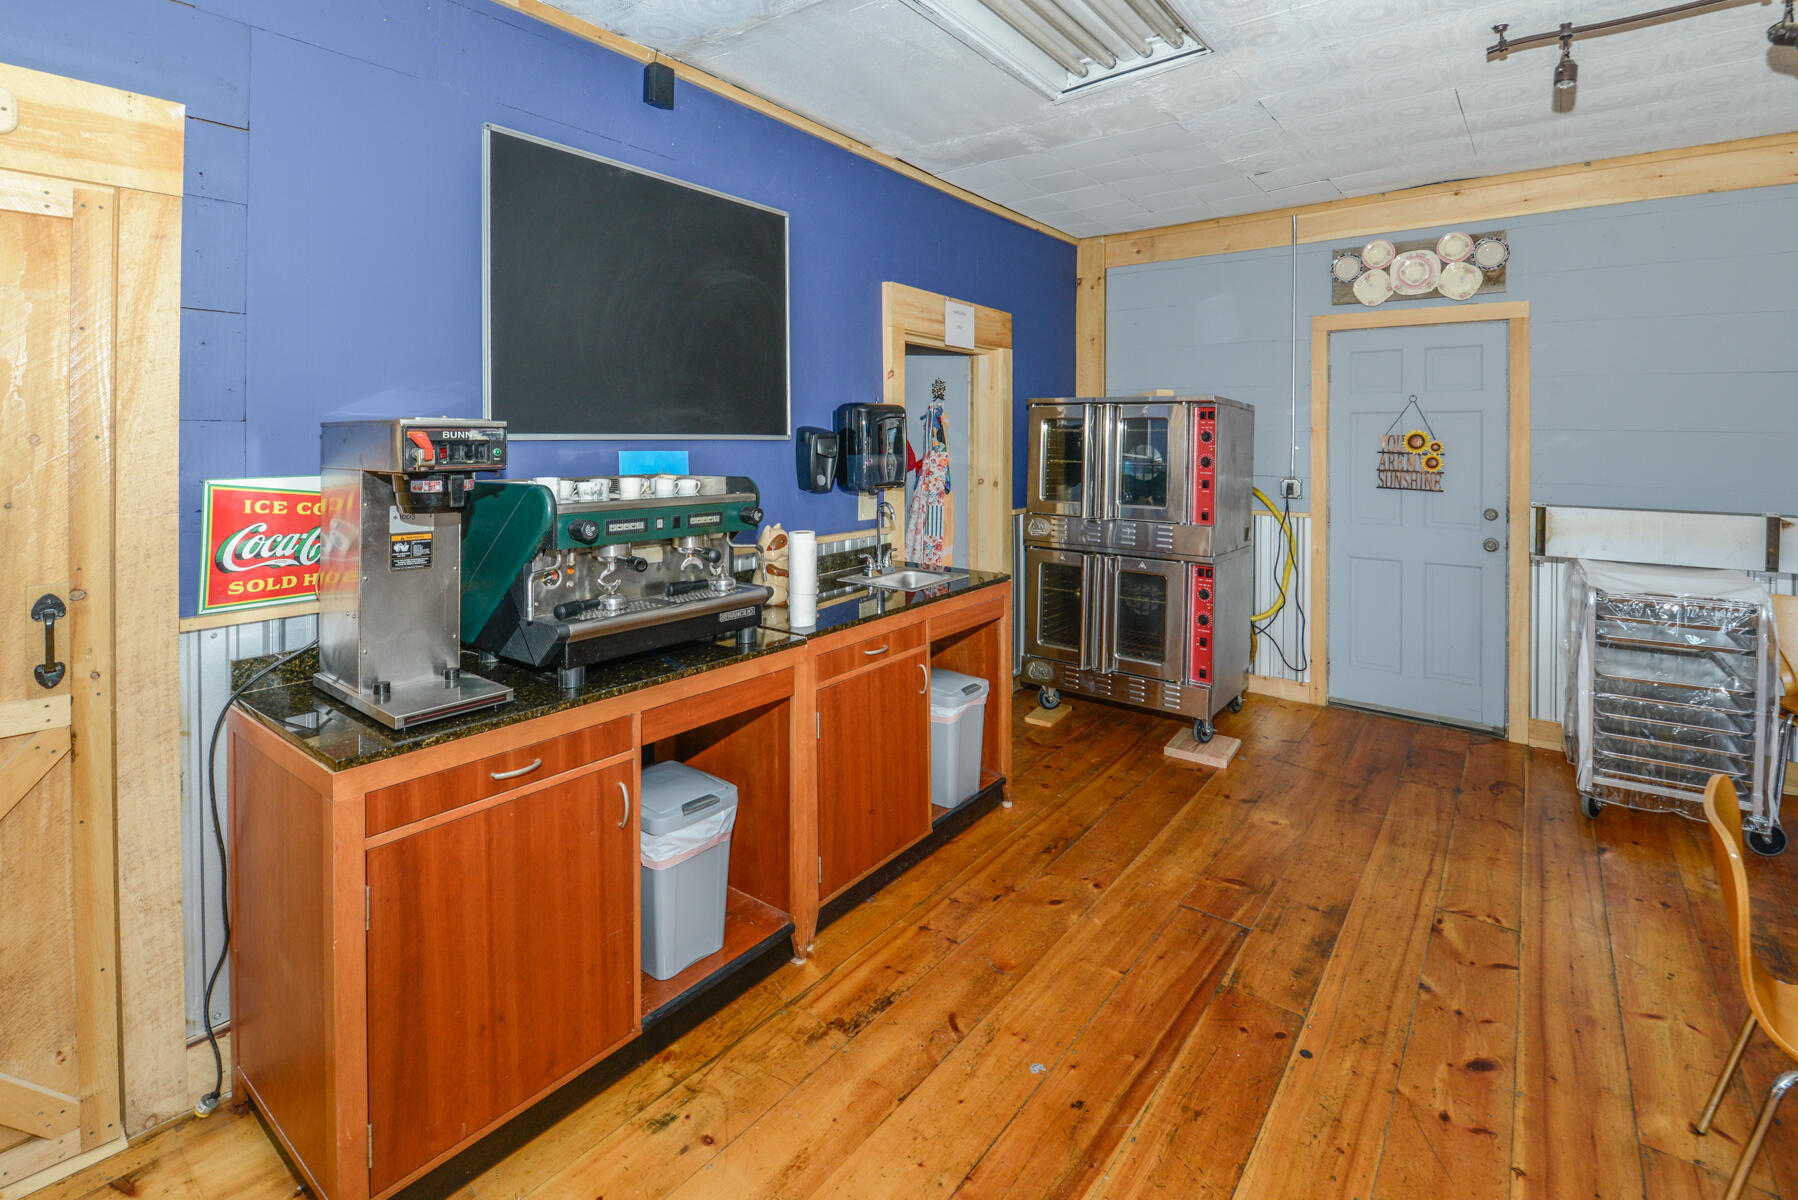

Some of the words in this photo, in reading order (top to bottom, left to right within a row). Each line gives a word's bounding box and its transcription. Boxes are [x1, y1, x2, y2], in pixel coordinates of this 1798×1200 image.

[1379, 434, 1405, 453] YOU
[1379, 453, 1404, 471] ARE
[1378, 471, 1442, 491] SUNSHINE
[244, 499, 288, 515] ICE
[216, 522, 321, 573] Coca-C
[227, 575, 298, 595] SOLD
